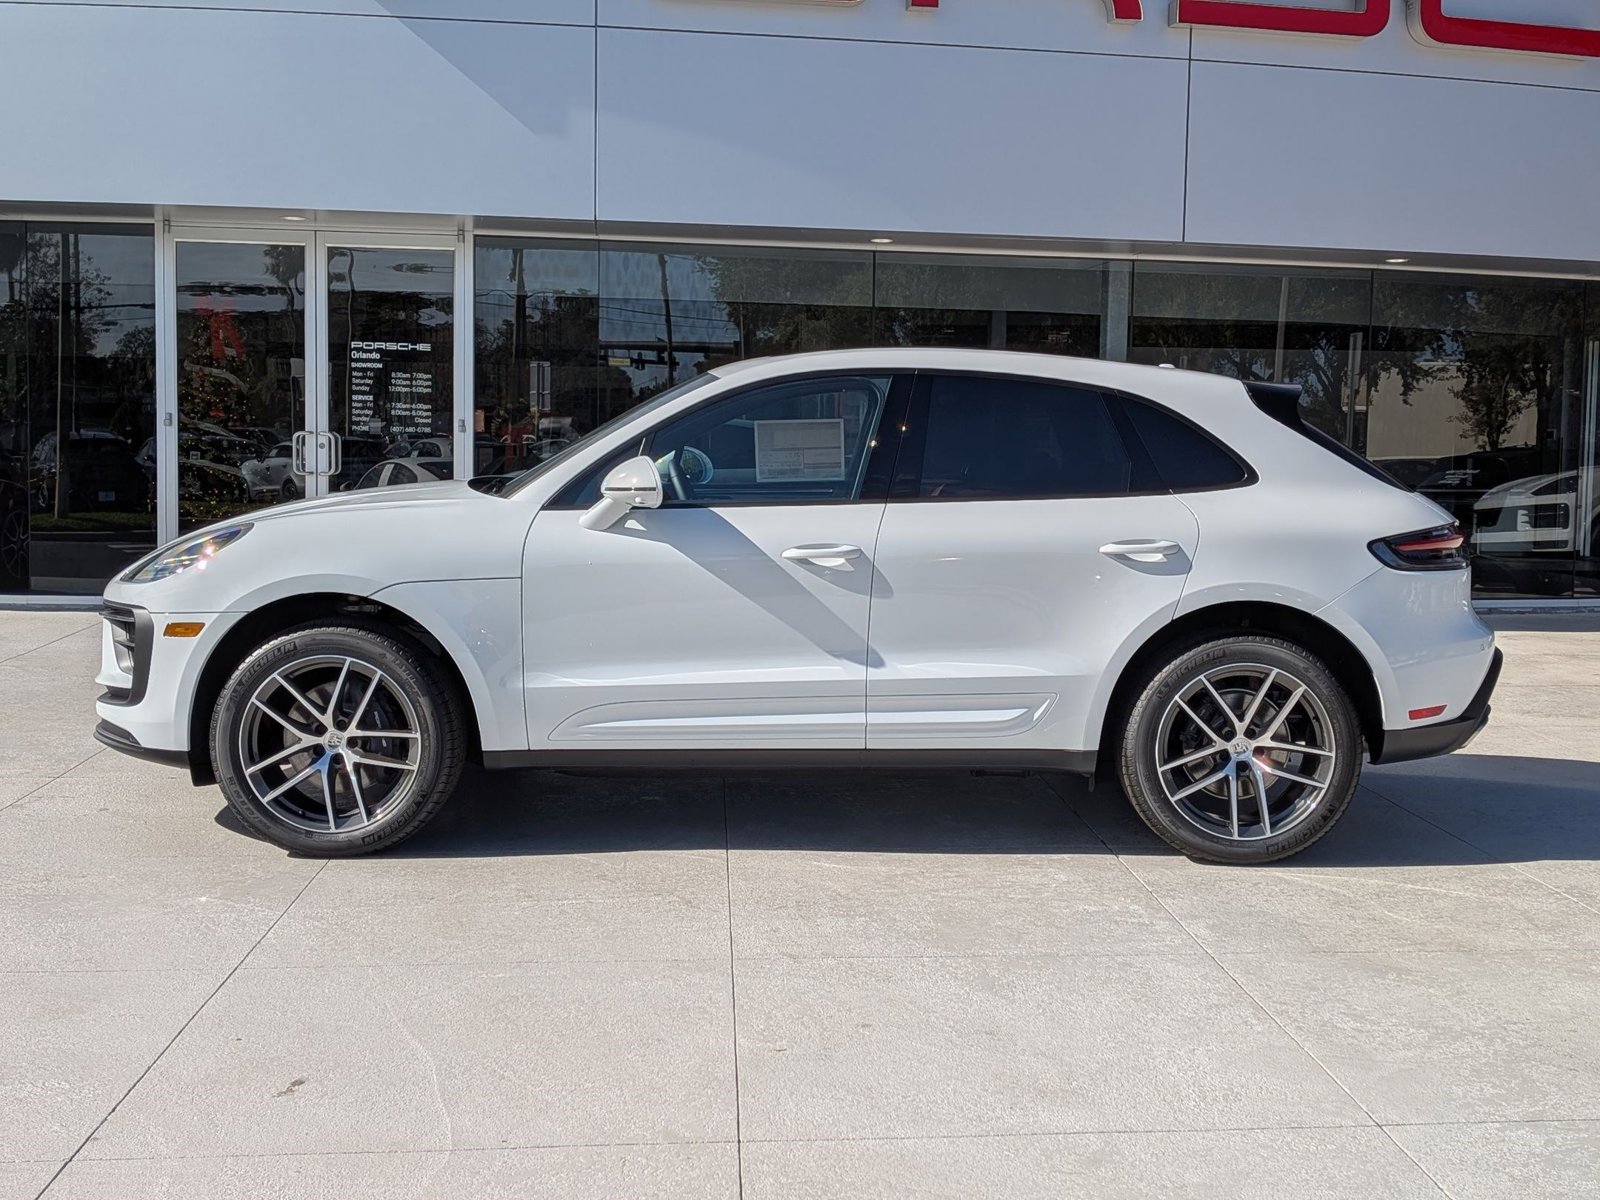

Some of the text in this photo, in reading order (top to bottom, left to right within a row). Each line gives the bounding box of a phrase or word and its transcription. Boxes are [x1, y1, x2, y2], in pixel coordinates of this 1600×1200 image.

[351, 342, 432, 351] PORSCHE
[351, 351, 380, 359] Orlando
[241, 641, 297, 684] MICHELIN
[1168, 649, 1225, 687] MICHELIN
